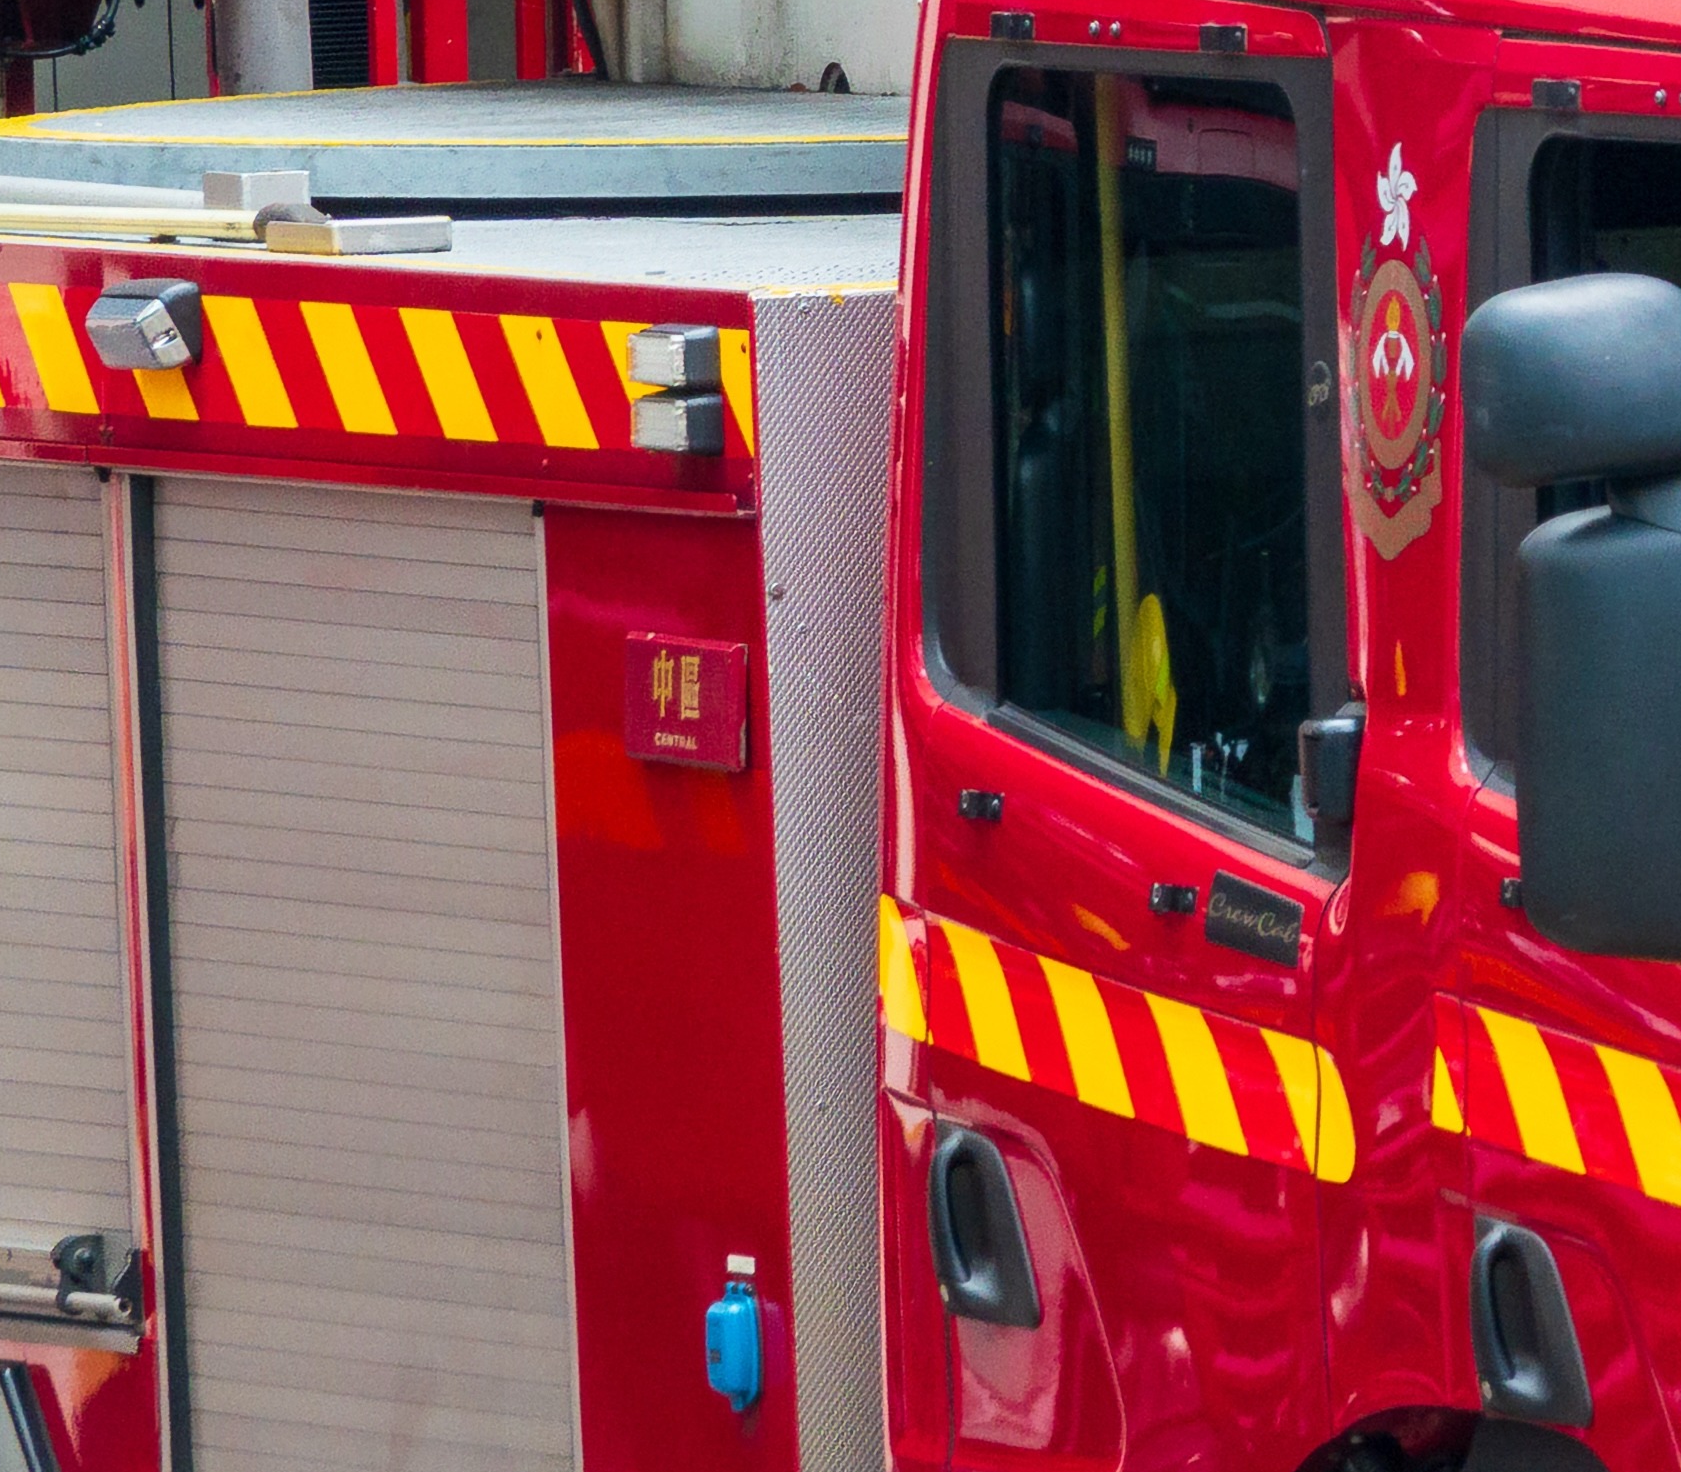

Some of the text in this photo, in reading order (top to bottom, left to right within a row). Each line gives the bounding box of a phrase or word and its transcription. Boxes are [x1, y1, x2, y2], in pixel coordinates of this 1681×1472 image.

[652, 649, 700, 720] 中區
[654, 732, 698, 751] CENTRAL
[1209, 893, 1297, 944] Crew Cab
